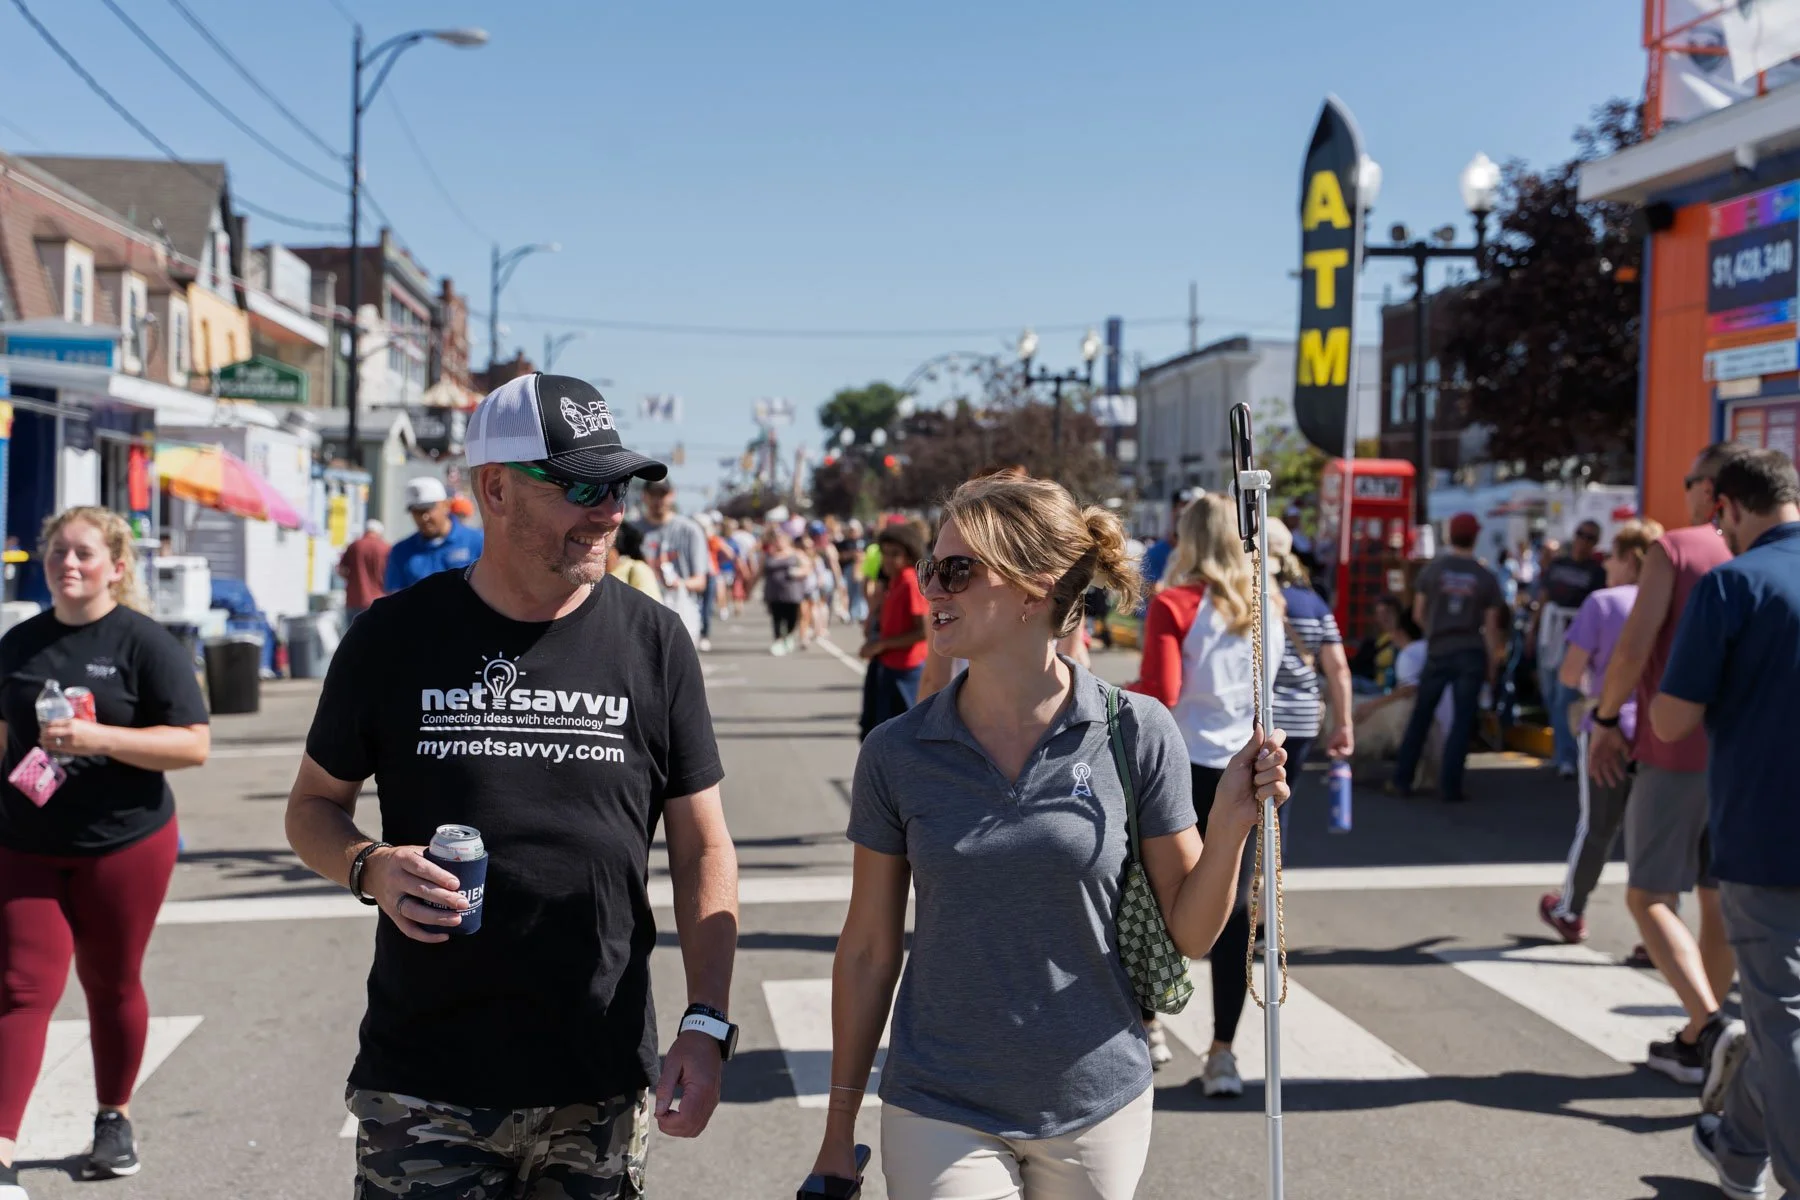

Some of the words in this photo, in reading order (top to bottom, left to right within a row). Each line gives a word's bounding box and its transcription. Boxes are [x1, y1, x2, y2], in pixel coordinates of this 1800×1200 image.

[1297, 169, 1352, 388] ATM
[588, 401, 609, 413] PE
[421, 682, 488, 711] net
[510, 688, 629, 726] savvy
[422, 713, 481, 724] Connecting
[483, 713, 514, 724] ideas
[515, 714, 541, 726] with
[543, 715, 604, 730] technology
[416, 737, 625, 763] mynetsavvy.com
